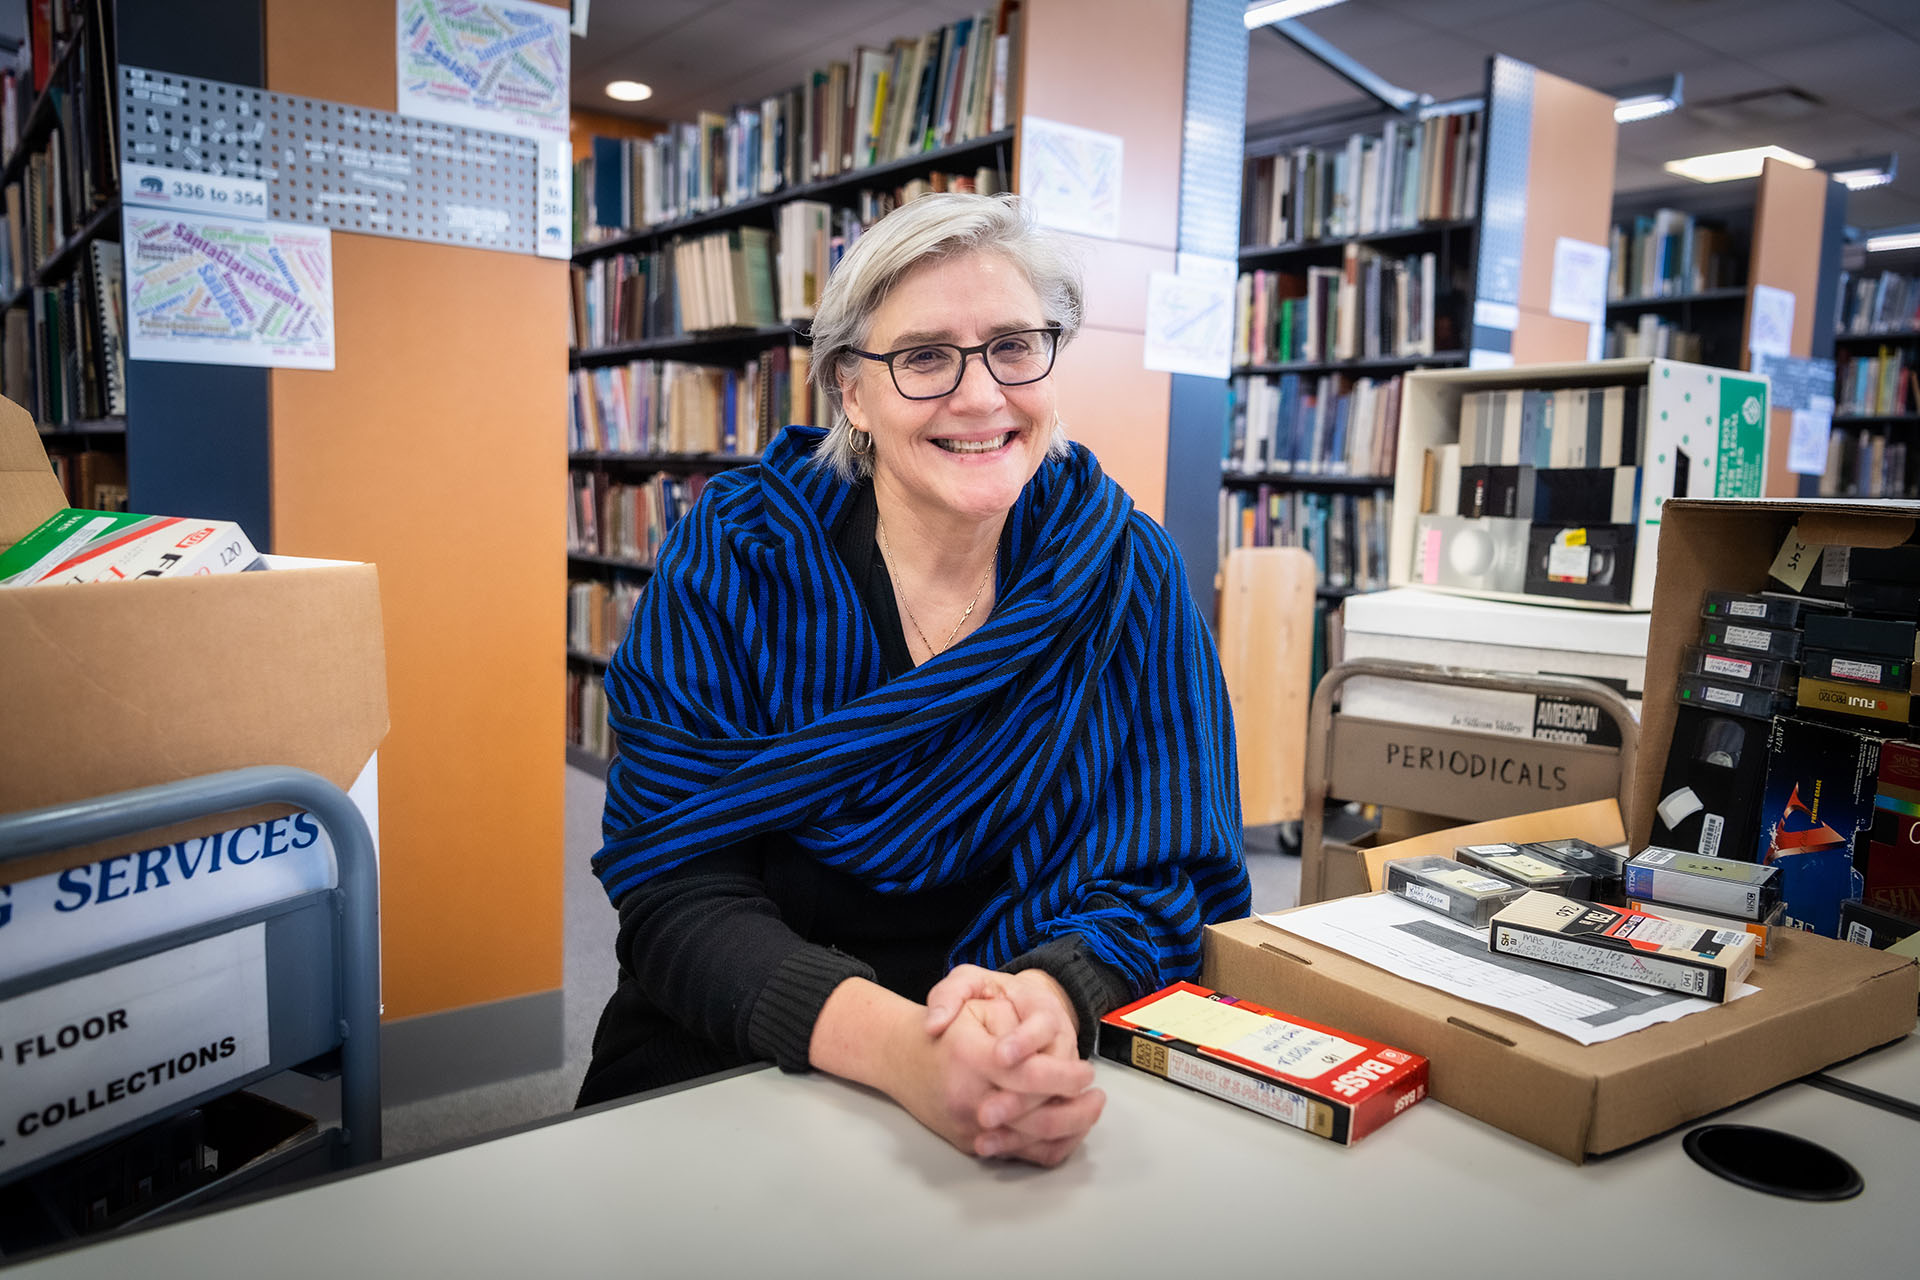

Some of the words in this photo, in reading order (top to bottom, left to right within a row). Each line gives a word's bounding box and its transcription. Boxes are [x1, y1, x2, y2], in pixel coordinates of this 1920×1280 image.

[173, 181, 205, 199] 336
[211, 183, 228, 201] to
[233, 188, 264, 206] 354
[173, 222, 304, 311] SantaClaraCounty
[1536, 701, 1600, 732] AMERICAN
[1848, 696, 1876, 710] FUJI
[1386, 742, 1568, 791] PERIODICALS
[1814, 779, 1823, 798] GRADE
[1811, 798, 1821, 824] PREMIUM
[54, 811, 320, 913] SERVICES
[15, 1008, 129, 1066] FLOOR
[17, 1036, 237, 1138] COLLECTIONS
[1332, 1058, 1395, 1097] BASF
[1394, 1089, 1418, 1115] BASF
